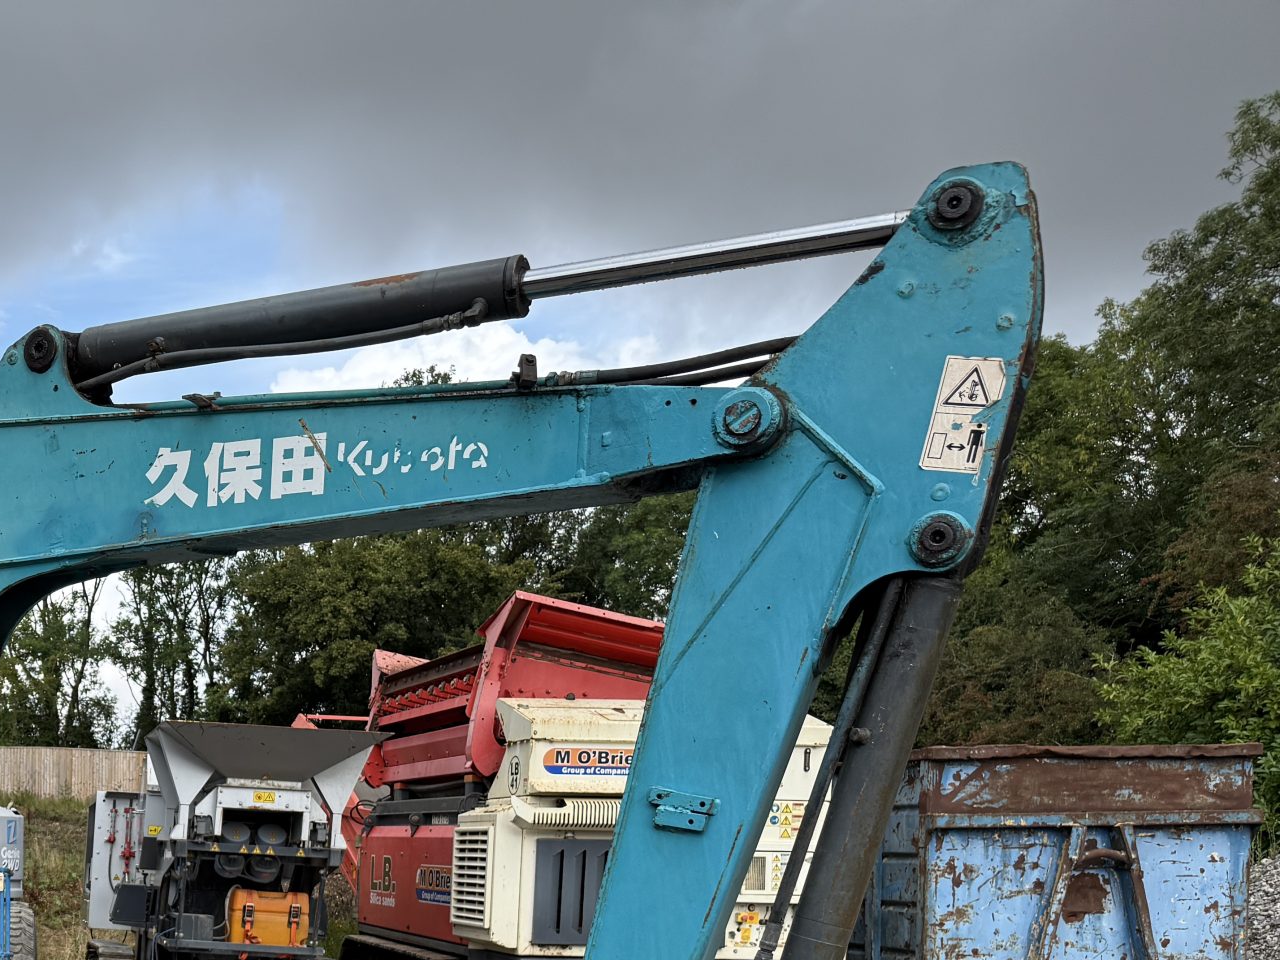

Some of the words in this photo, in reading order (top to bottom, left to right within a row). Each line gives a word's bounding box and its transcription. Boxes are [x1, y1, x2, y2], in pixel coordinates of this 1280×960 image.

[144, 433, 329, 508] 久保田
[556, 751, 570, 764] M
[510, 763, 519, 776] LB
[562, 767, 584, 776] Group
[586, 767, 594, 775] of
[510, 777, 518, 789] 41
[2, 860, 20, 872] 2WD
[370, 854, 396, 894] L.B.
[420, 868, 426, 887] M
